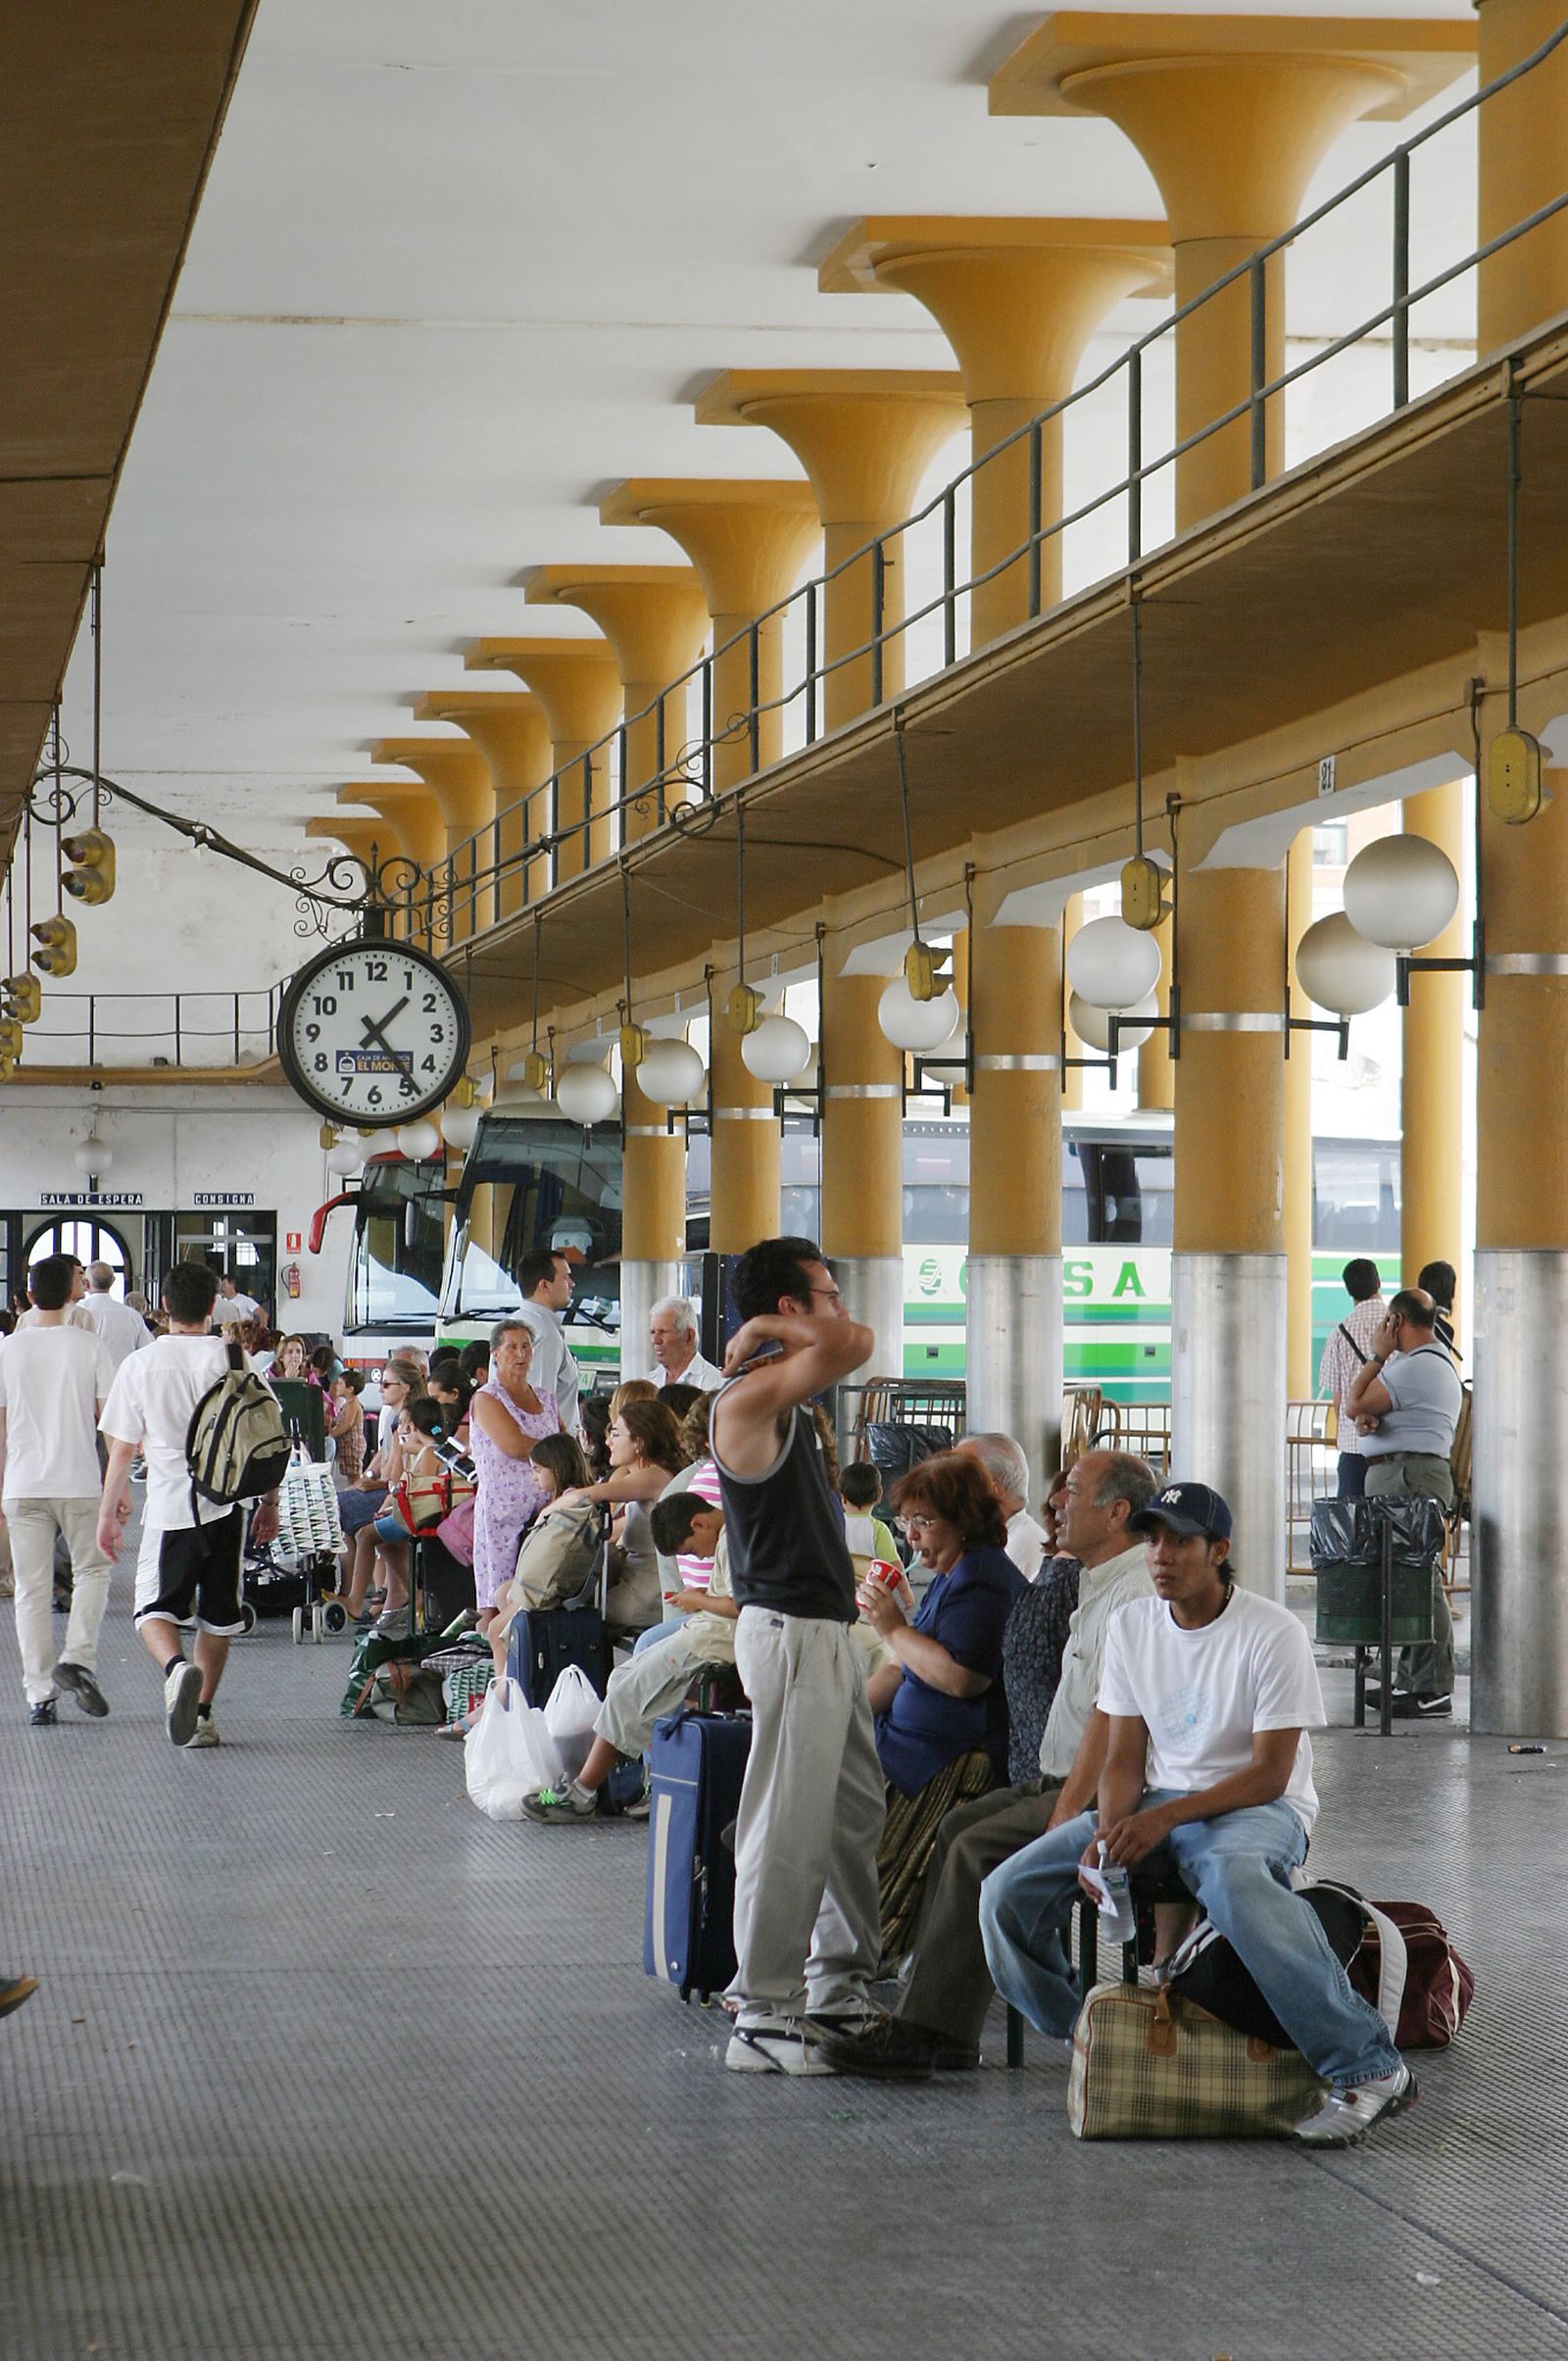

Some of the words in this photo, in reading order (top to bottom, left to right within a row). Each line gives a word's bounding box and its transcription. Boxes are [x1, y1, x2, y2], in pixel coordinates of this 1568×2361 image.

[1321, 760, 1332, 791] 21
[365, 961, 387, 981] 12
[336, 971, 354, 991] 11
[404, 971, 412, 991] 1
[313, 996, 337, 1015] 10
[422, 993, 436, 1012] 2
[306, 1023, 320, 1043] 9
[430, 1023, 444, 1043] 3
[314, 1053, 328, 1072] 8
[357, 1061, 369, 1071] EL
[421, 1054, 436, 1073] 4
[340, 1077, 353, 1096] 7
[368, 1085, 382, 1105] 6
[399, 1077, 413, 1097] 5
[42, 1194, 71, 1205] SALA
[77, 1194, 91, 1205] DE
[98, 1194, 142, 1205] ESPERA
[195, 1194, 253, 1205] CONSIGNA
[1160, 1489, 1183, 1504] NY
